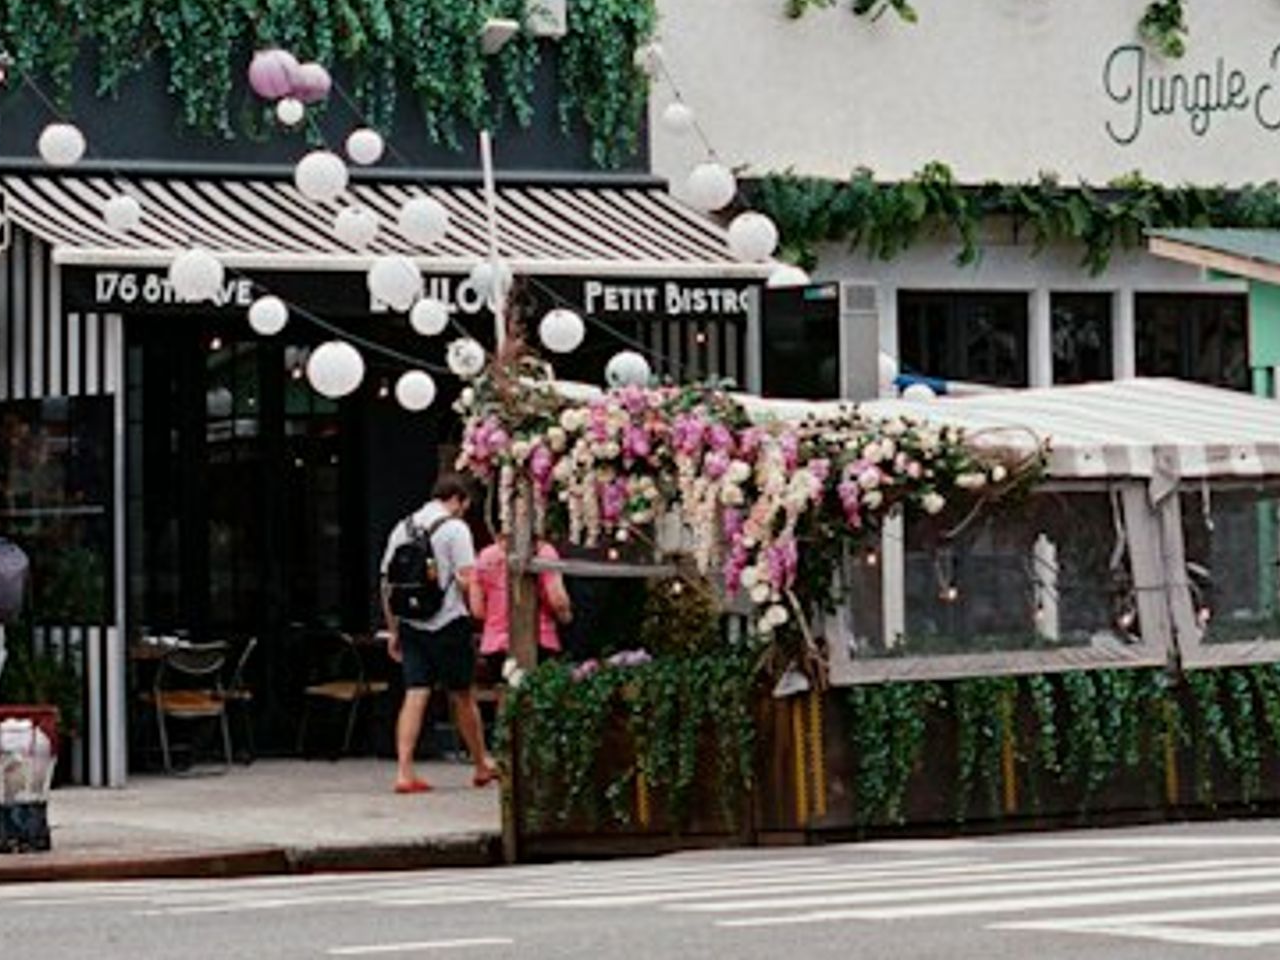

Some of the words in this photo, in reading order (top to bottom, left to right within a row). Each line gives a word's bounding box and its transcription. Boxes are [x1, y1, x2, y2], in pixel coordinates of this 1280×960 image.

[1103, 45, 1249, 145] Jungle
[96, 273, 138, 303] 176
[142, 273, 189, 304] 8T
